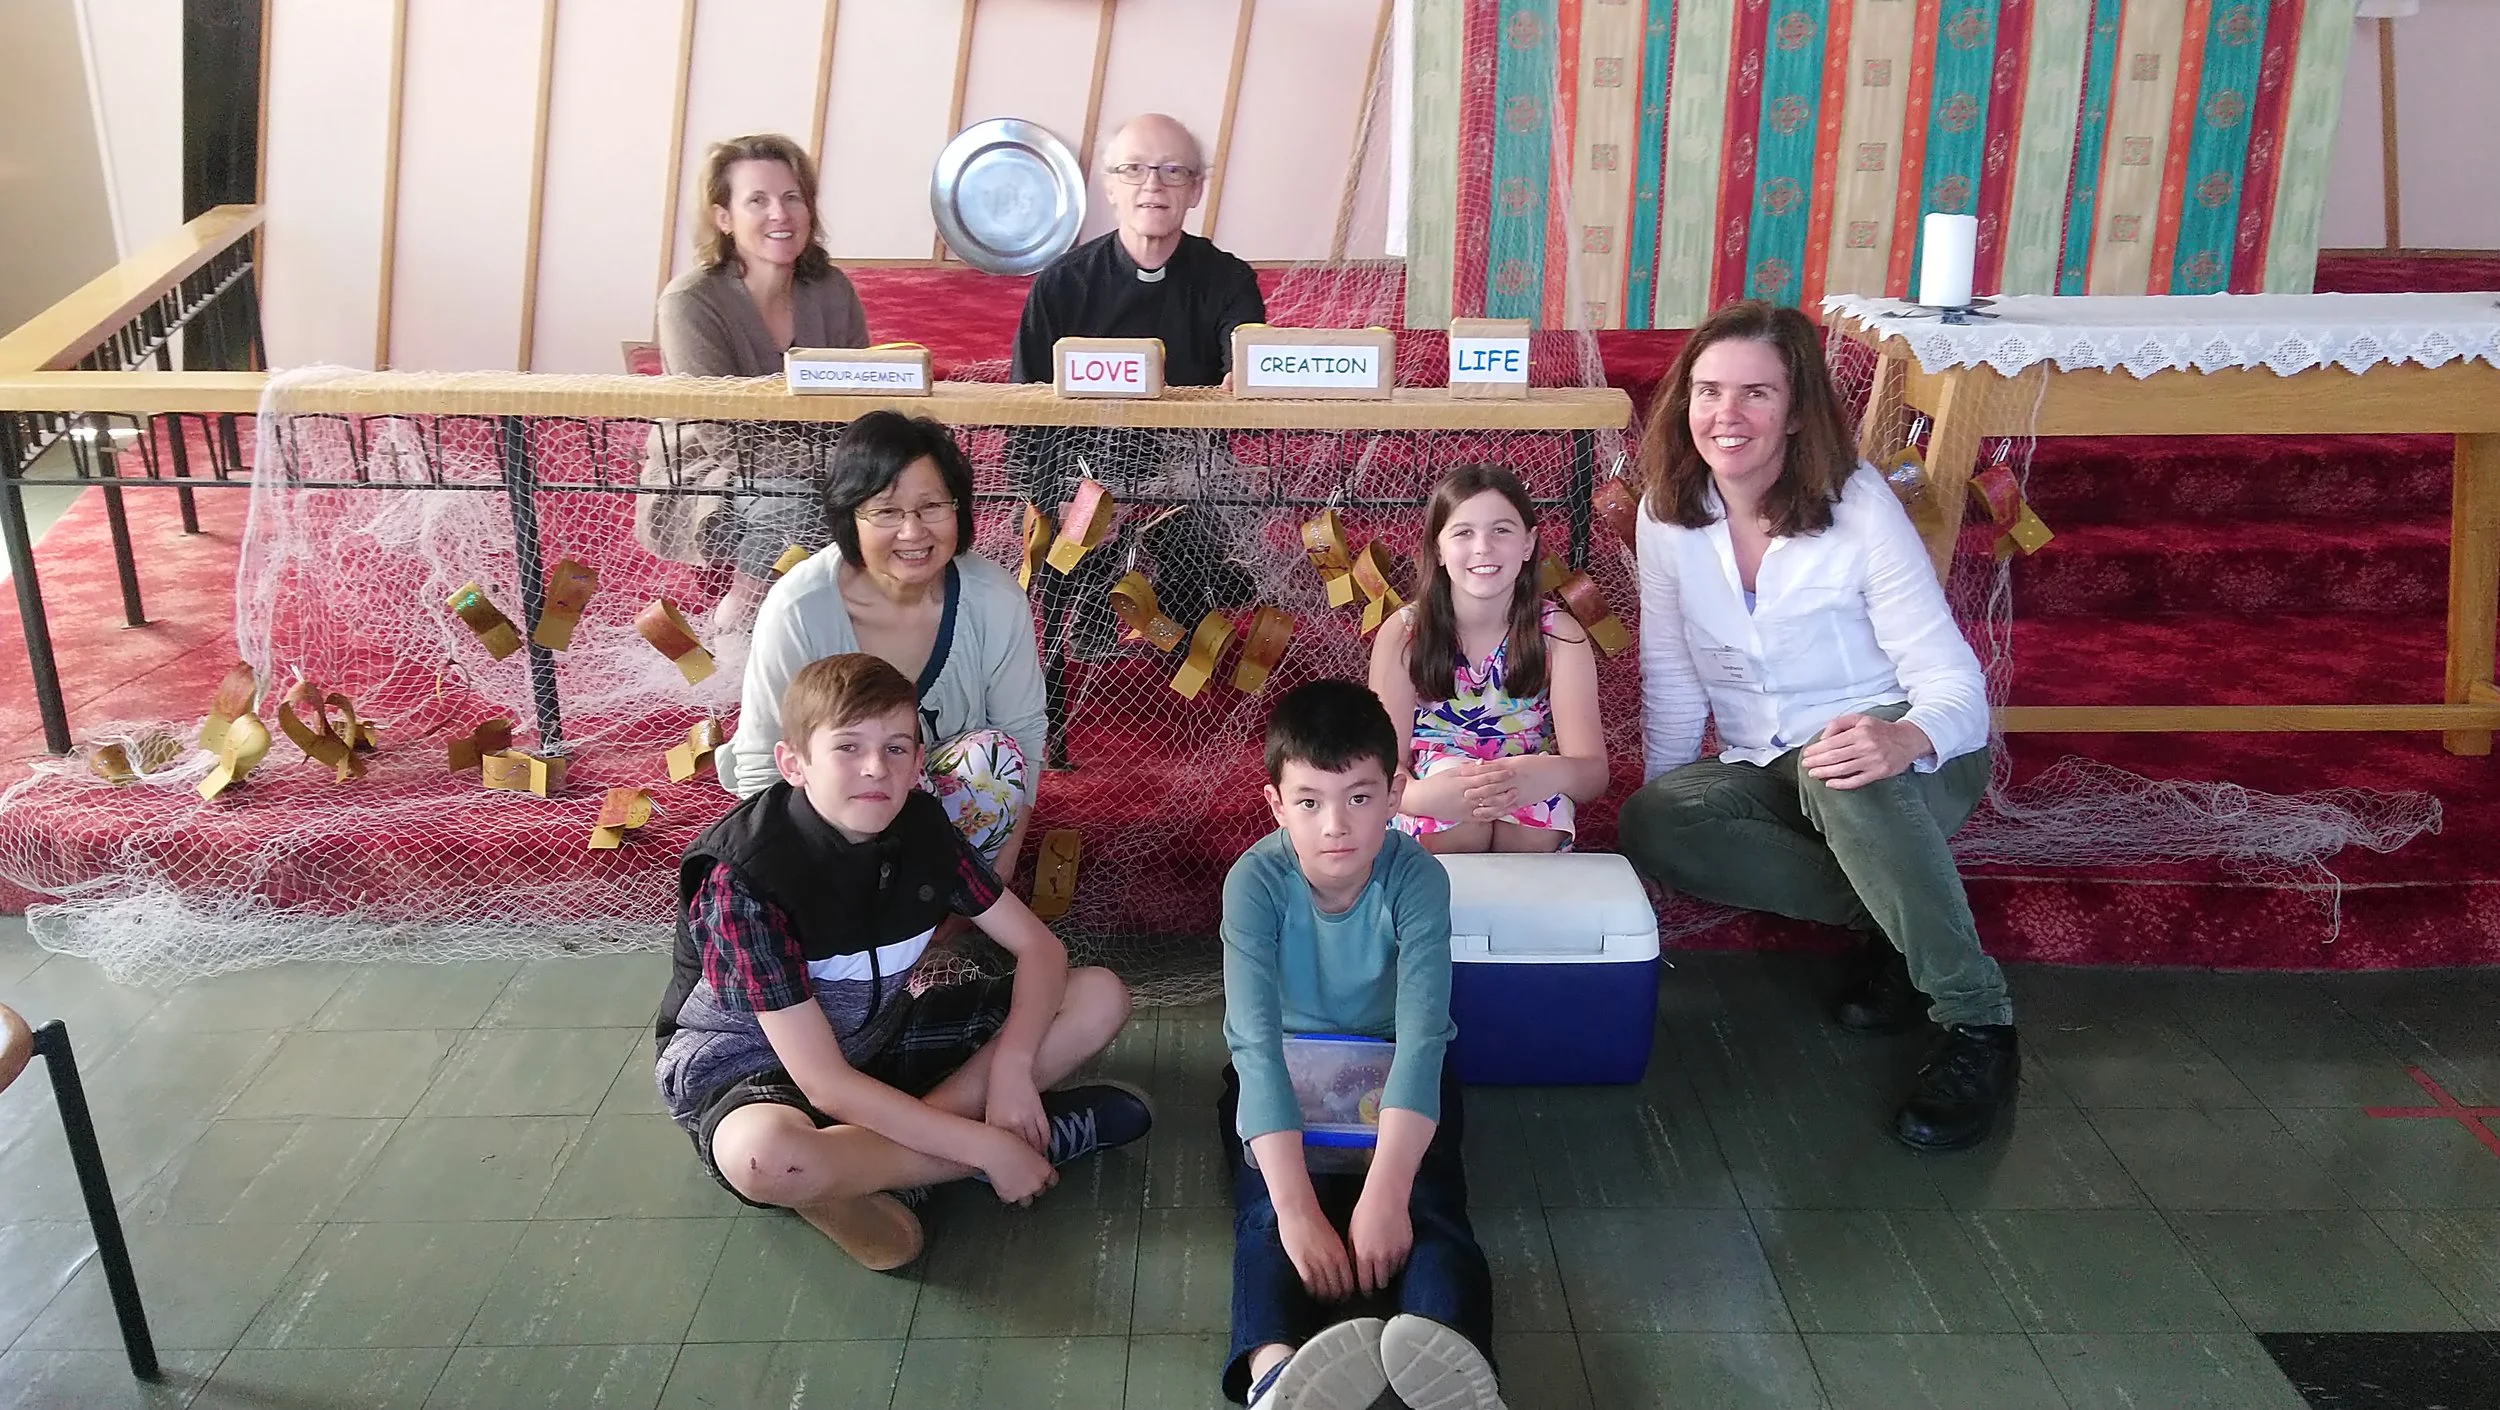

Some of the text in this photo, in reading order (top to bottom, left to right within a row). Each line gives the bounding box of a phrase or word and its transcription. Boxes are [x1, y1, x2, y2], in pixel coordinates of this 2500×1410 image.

[1260, 356, 1367, 374] CREATION
[1458, 350, 1520, 371] LIFE
[800, 369, 915, 384] ENCOURAGEMENT
[1071, 359, 1139, 383] LOVE
